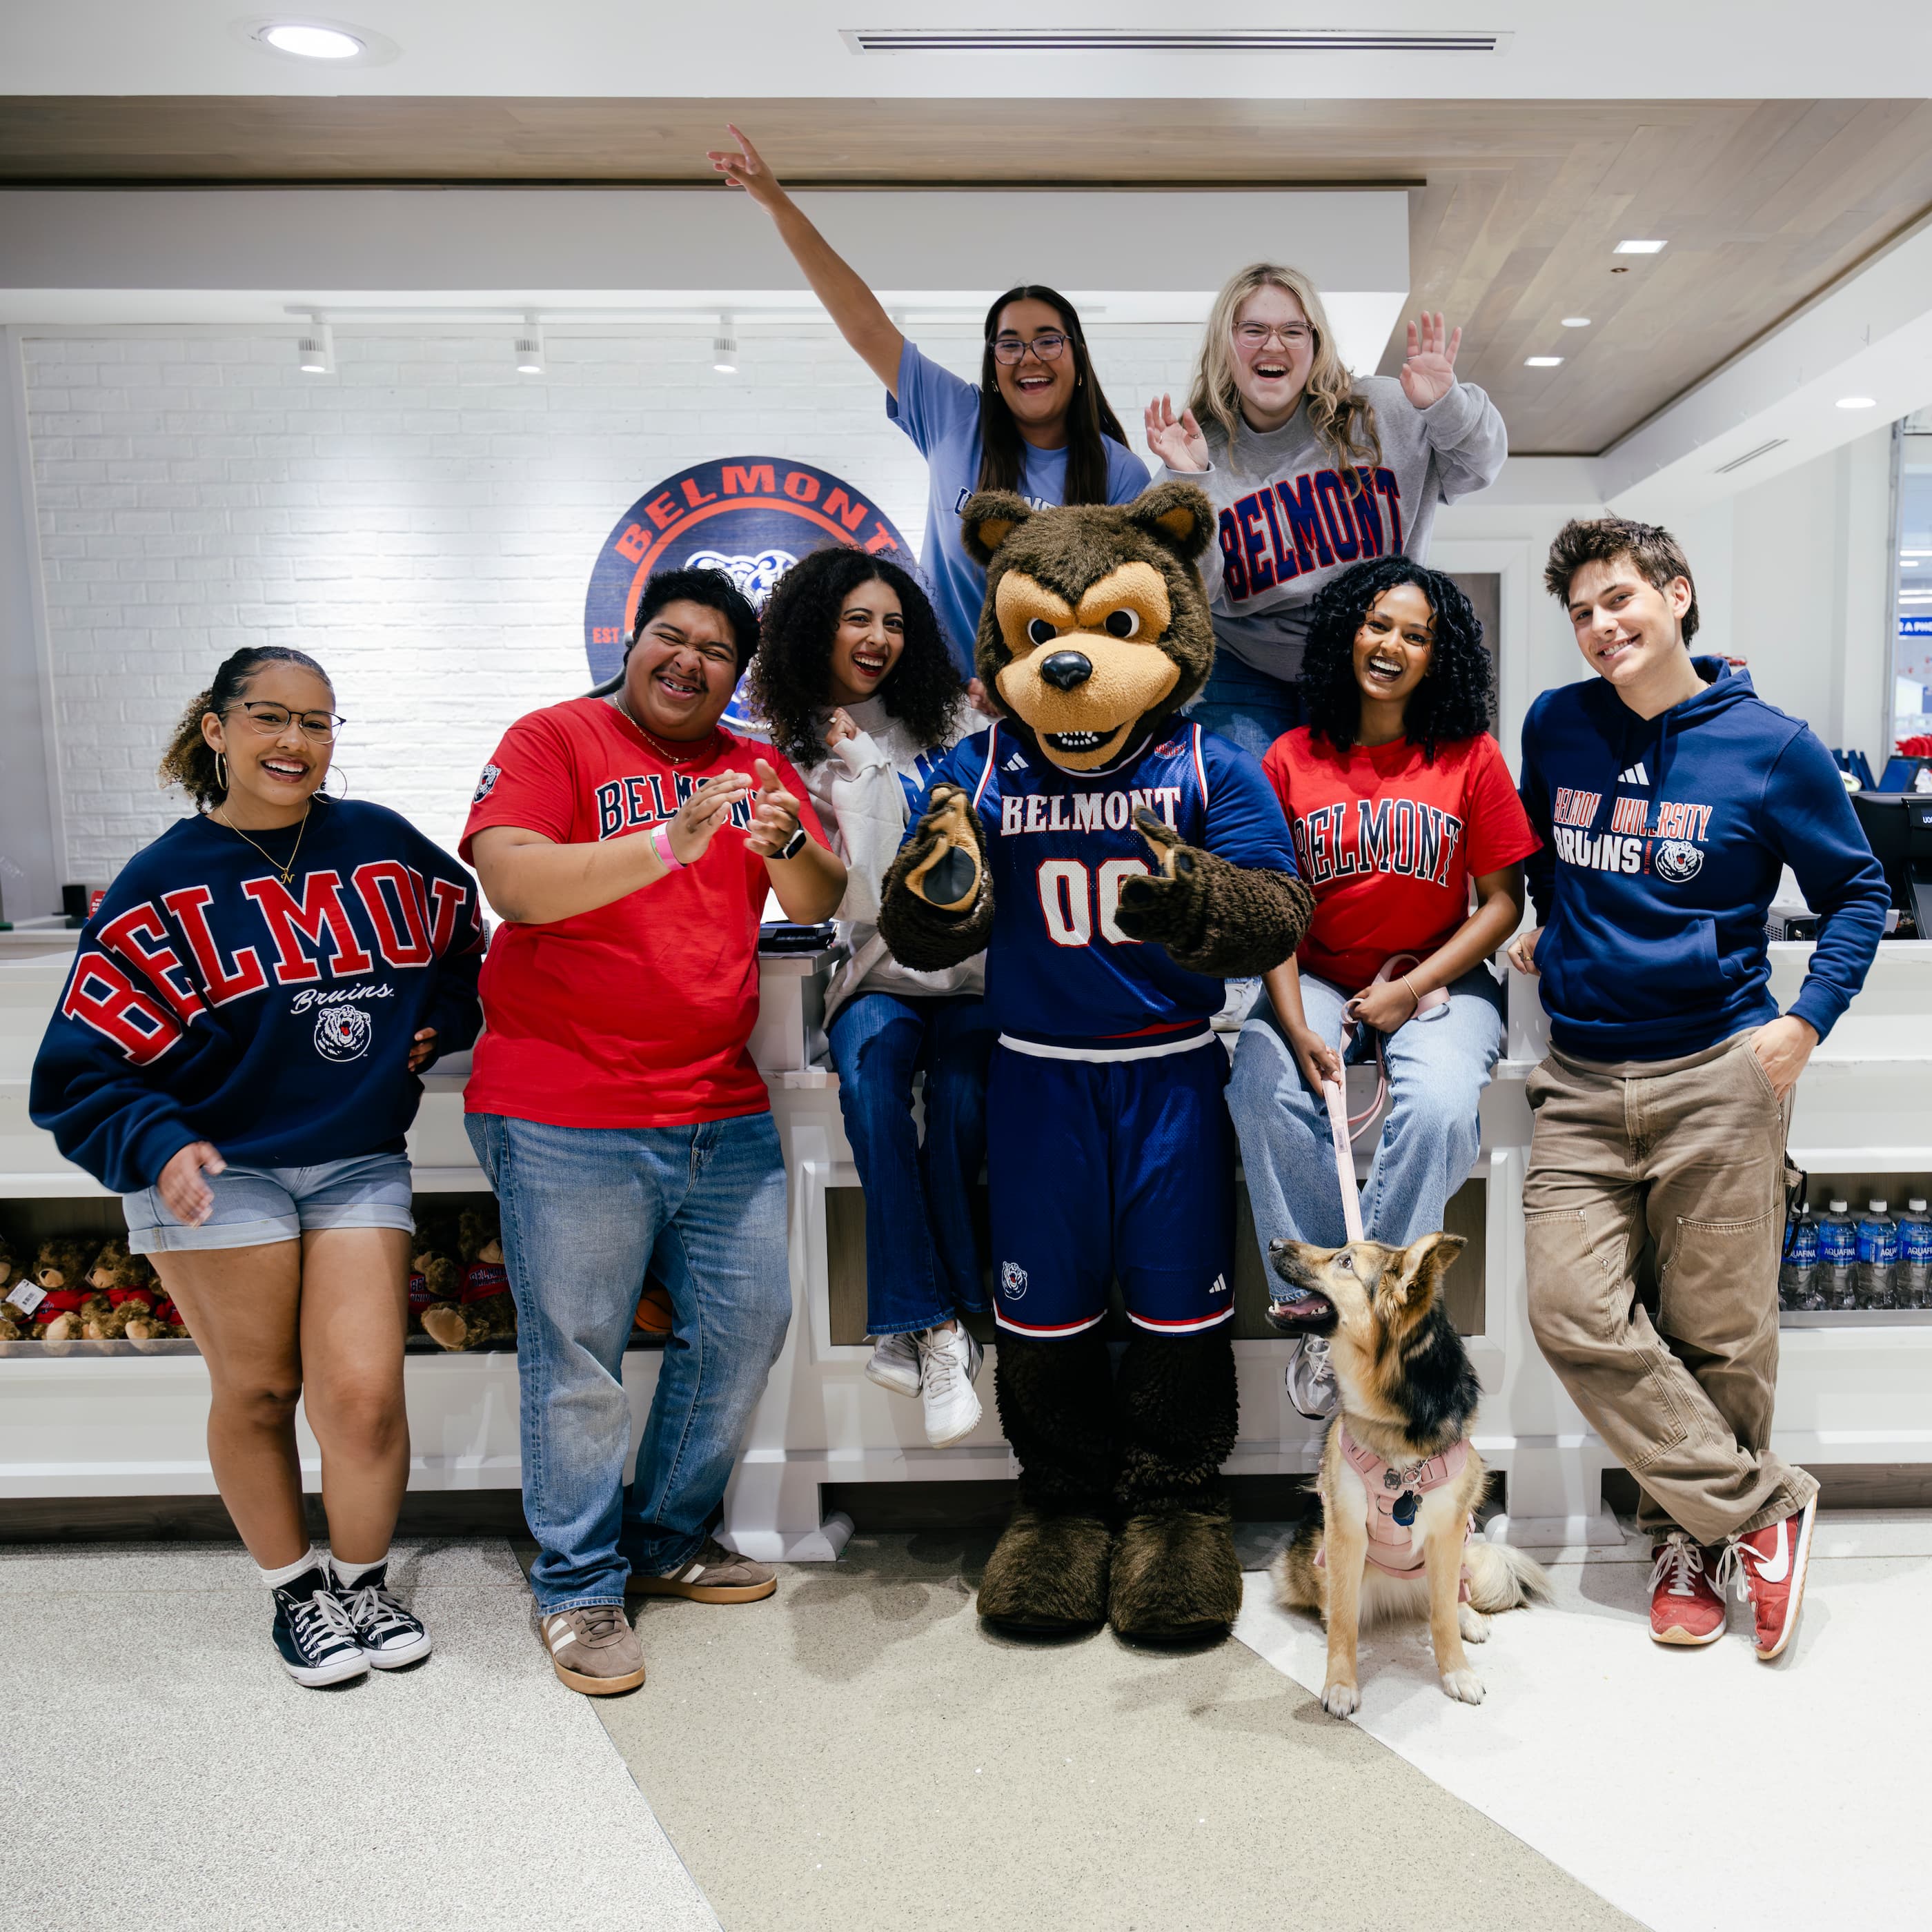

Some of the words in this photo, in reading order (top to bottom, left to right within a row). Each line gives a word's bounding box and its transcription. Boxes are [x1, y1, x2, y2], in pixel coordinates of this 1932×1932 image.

[614, 464, 897, 564] BELMONT
[1219, 466, 1403, 602] BELMONT
[593, 627, 619, 644] EST
[1553, 826, 1643, 874] BRUINS
[290, 982, 393, 1014] Bruins
[1824, 1247, 1855, 1258] AQUAFINA
